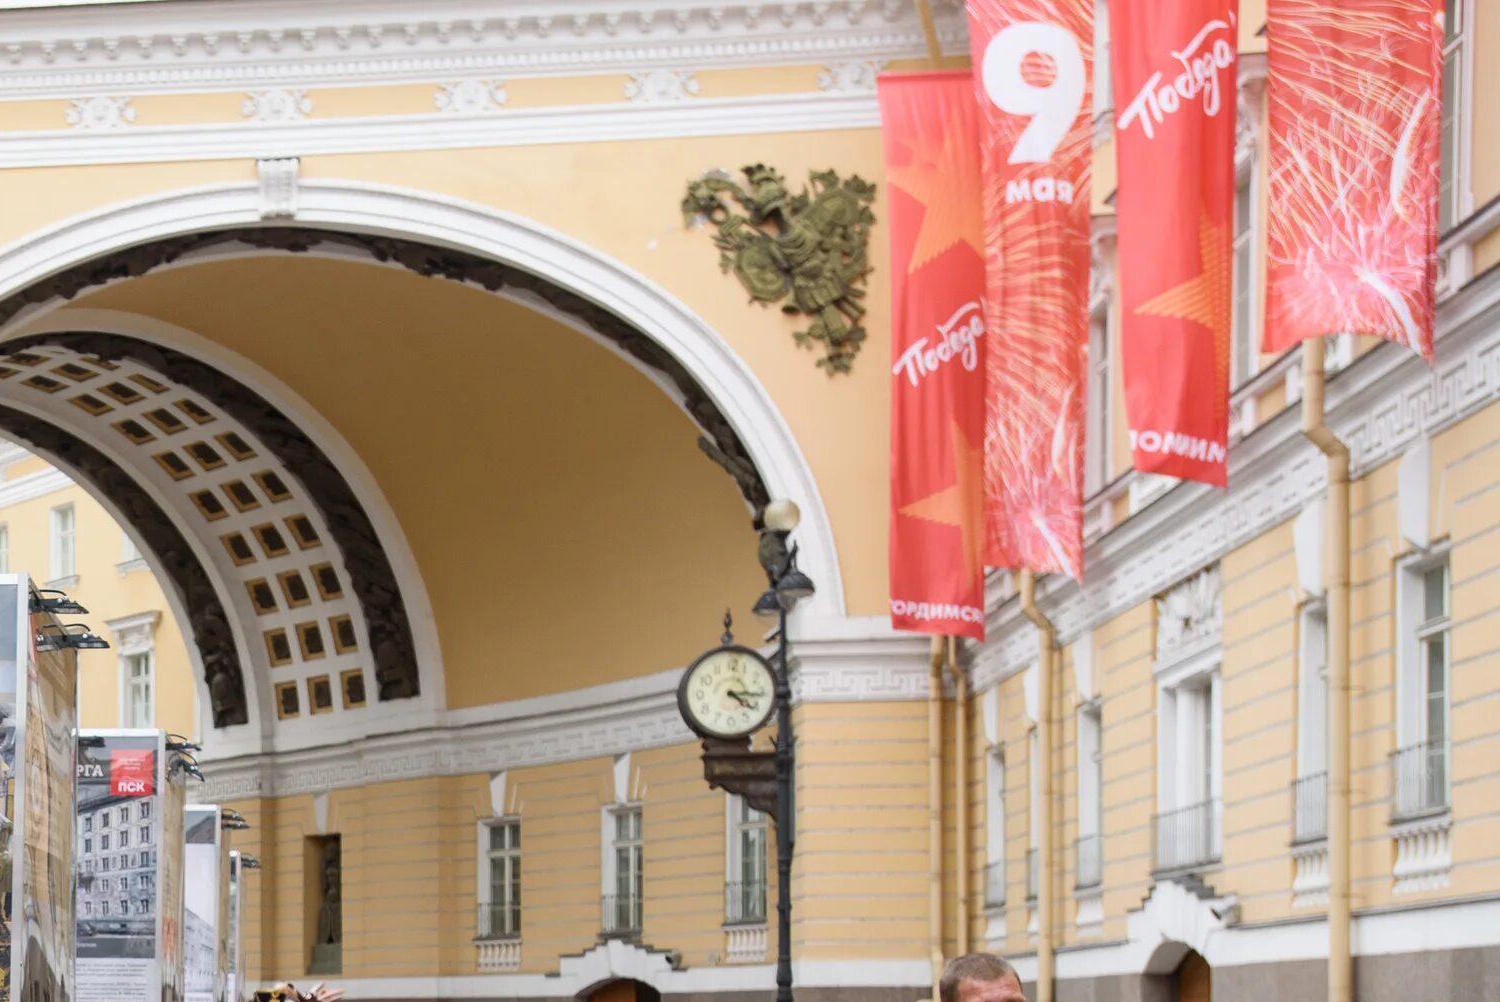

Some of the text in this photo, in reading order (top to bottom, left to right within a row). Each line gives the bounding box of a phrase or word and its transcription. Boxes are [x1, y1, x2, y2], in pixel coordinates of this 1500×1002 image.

[981, 21, 1087, 166] 9
[1006, 175, 1074, 205] мая
[891, 599, 984, 624] ОРДИМСЯ
